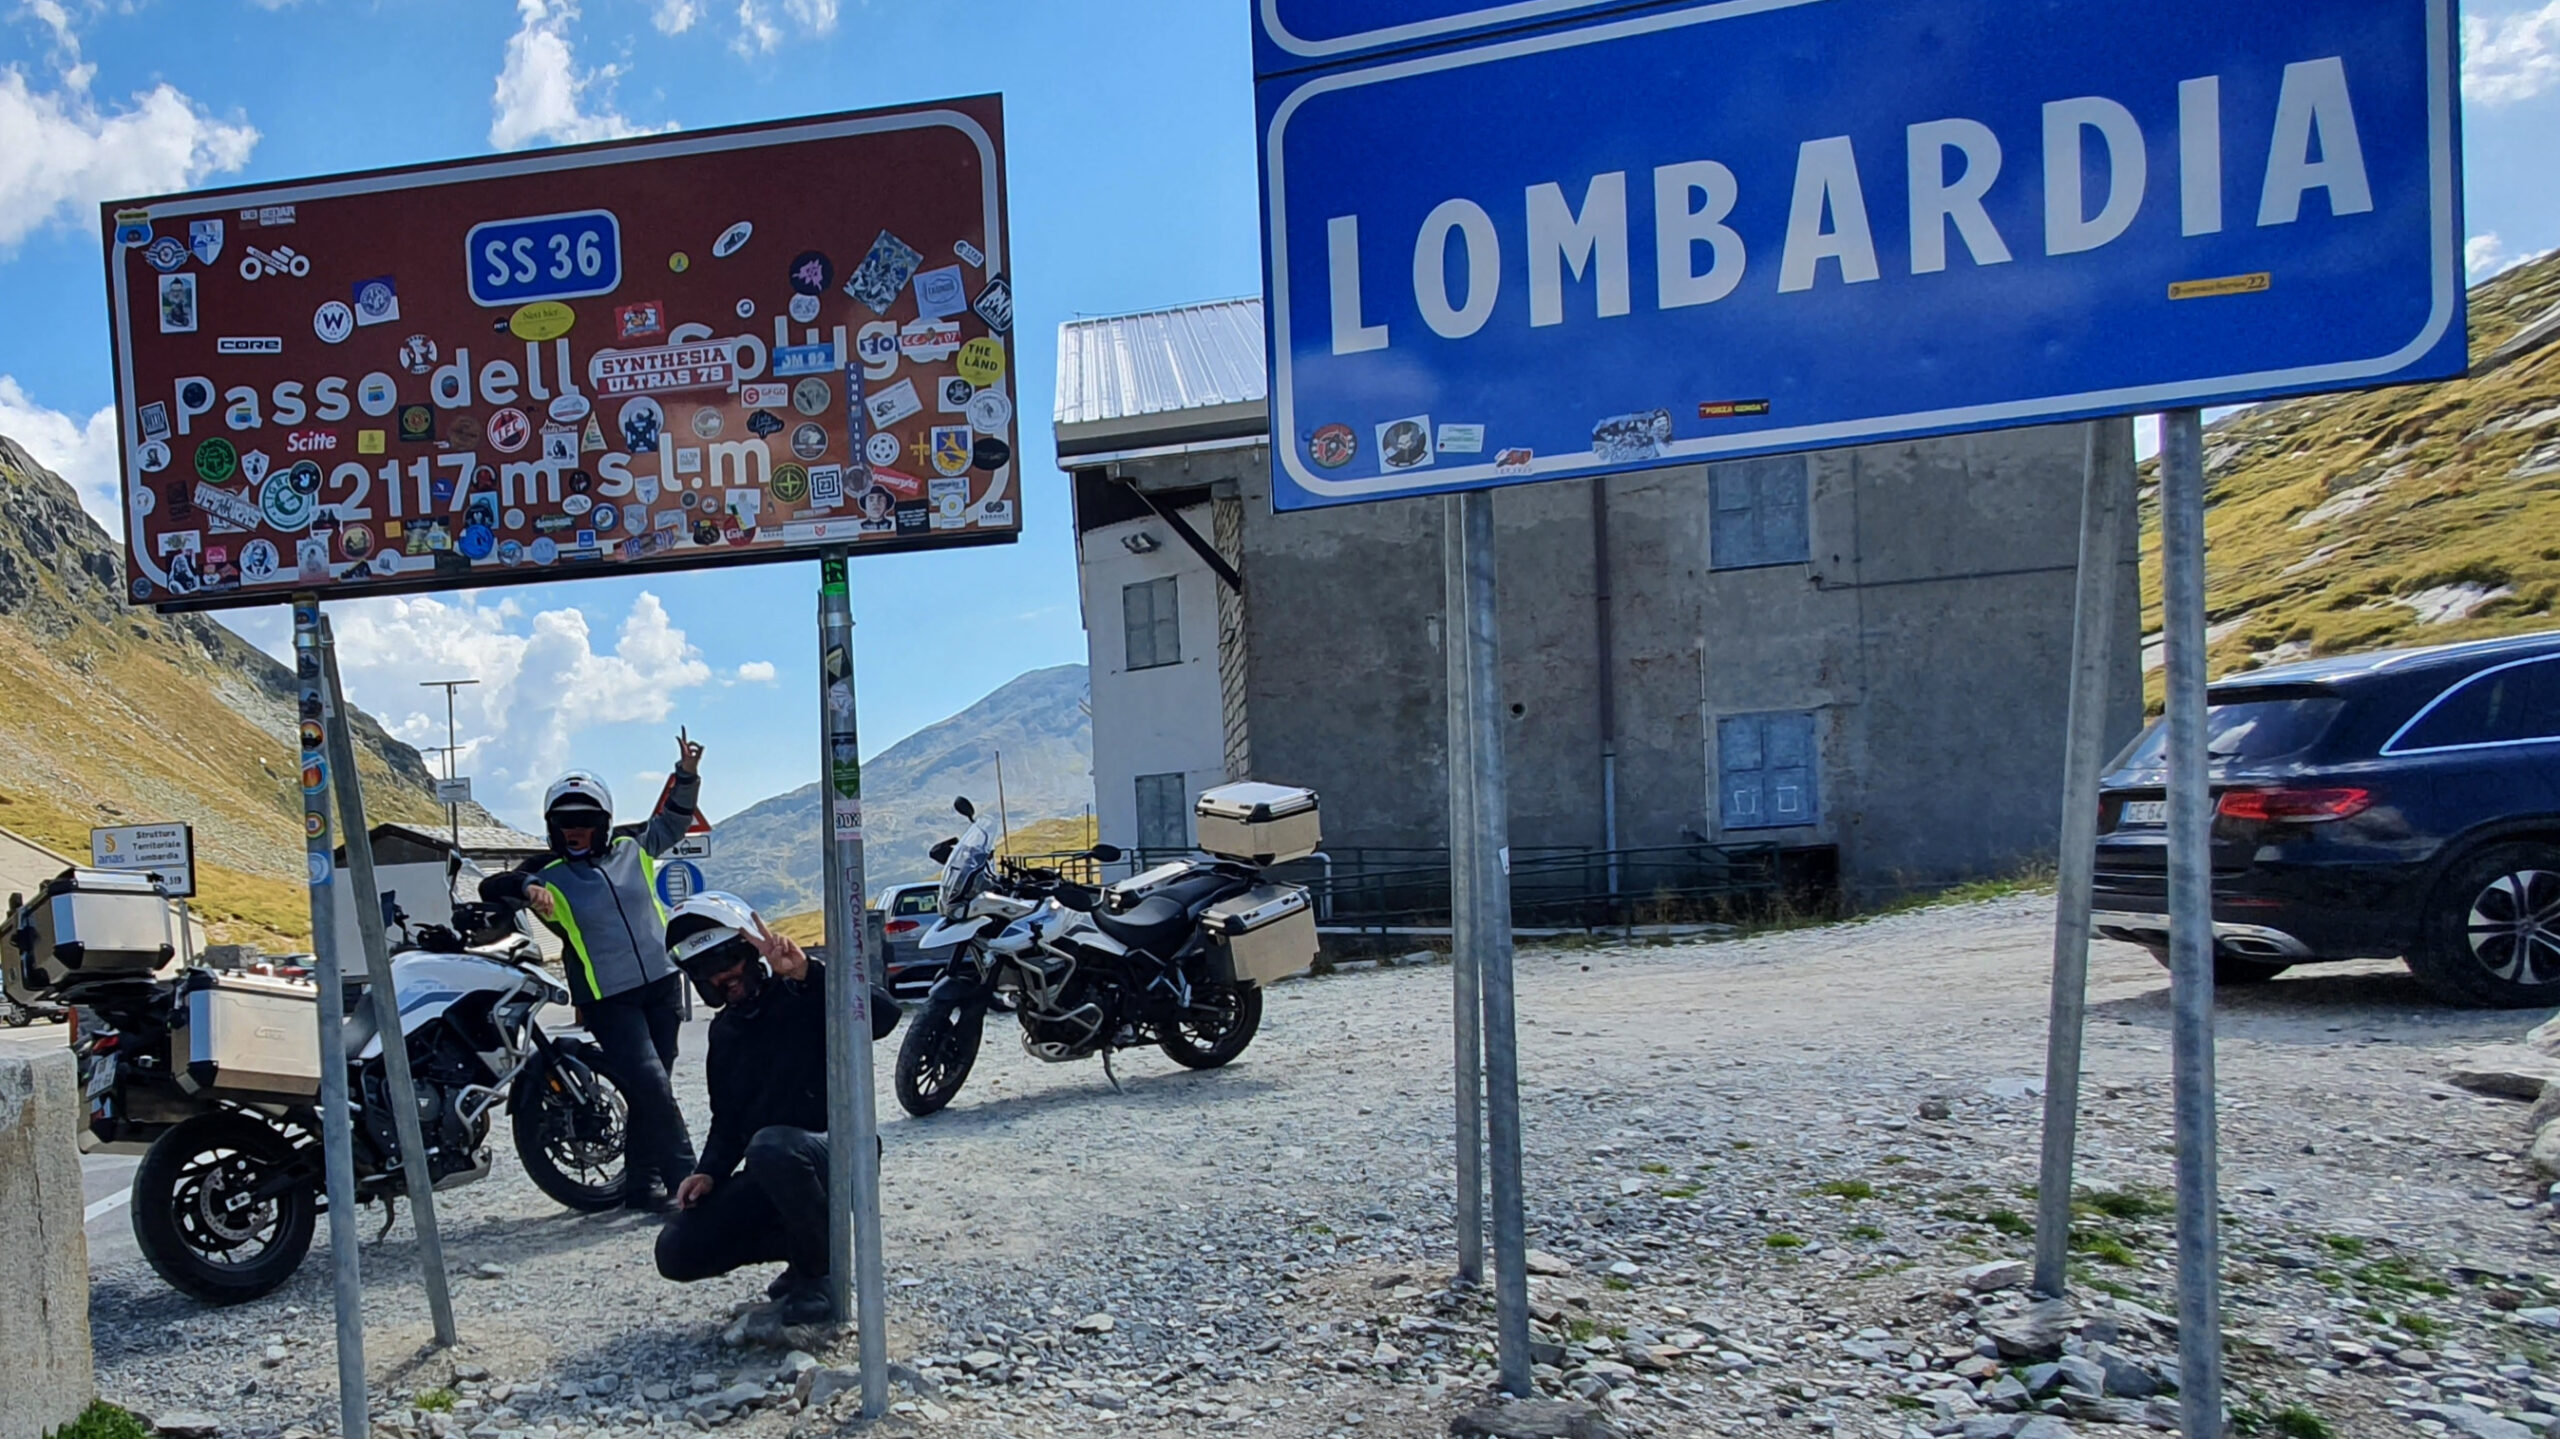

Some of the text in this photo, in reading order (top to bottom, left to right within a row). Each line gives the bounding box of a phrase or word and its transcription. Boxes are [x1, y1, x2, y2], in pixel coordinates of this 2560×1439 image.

[1327, 55, 2373, 356] LOMBARDIA
[485, 231, 601, 286] SS 36
[322, 312, 344, 330] W
[968, 344, 992, 357] THE
[602, 347, 728, 375] SYNTHESIA
[607, 370, 691, 393] ULTRAS
[174, 371, 397, 435] Passo
[329, 451, 476, 521] 2117
[500, 460, 561, 507] m
[136, 830, 176, 839] Struttura
[132, 841, 181, 851] Territoriale
[97, 854, 126, 864] anas
[135, 852, 179, 862] Lombardia
